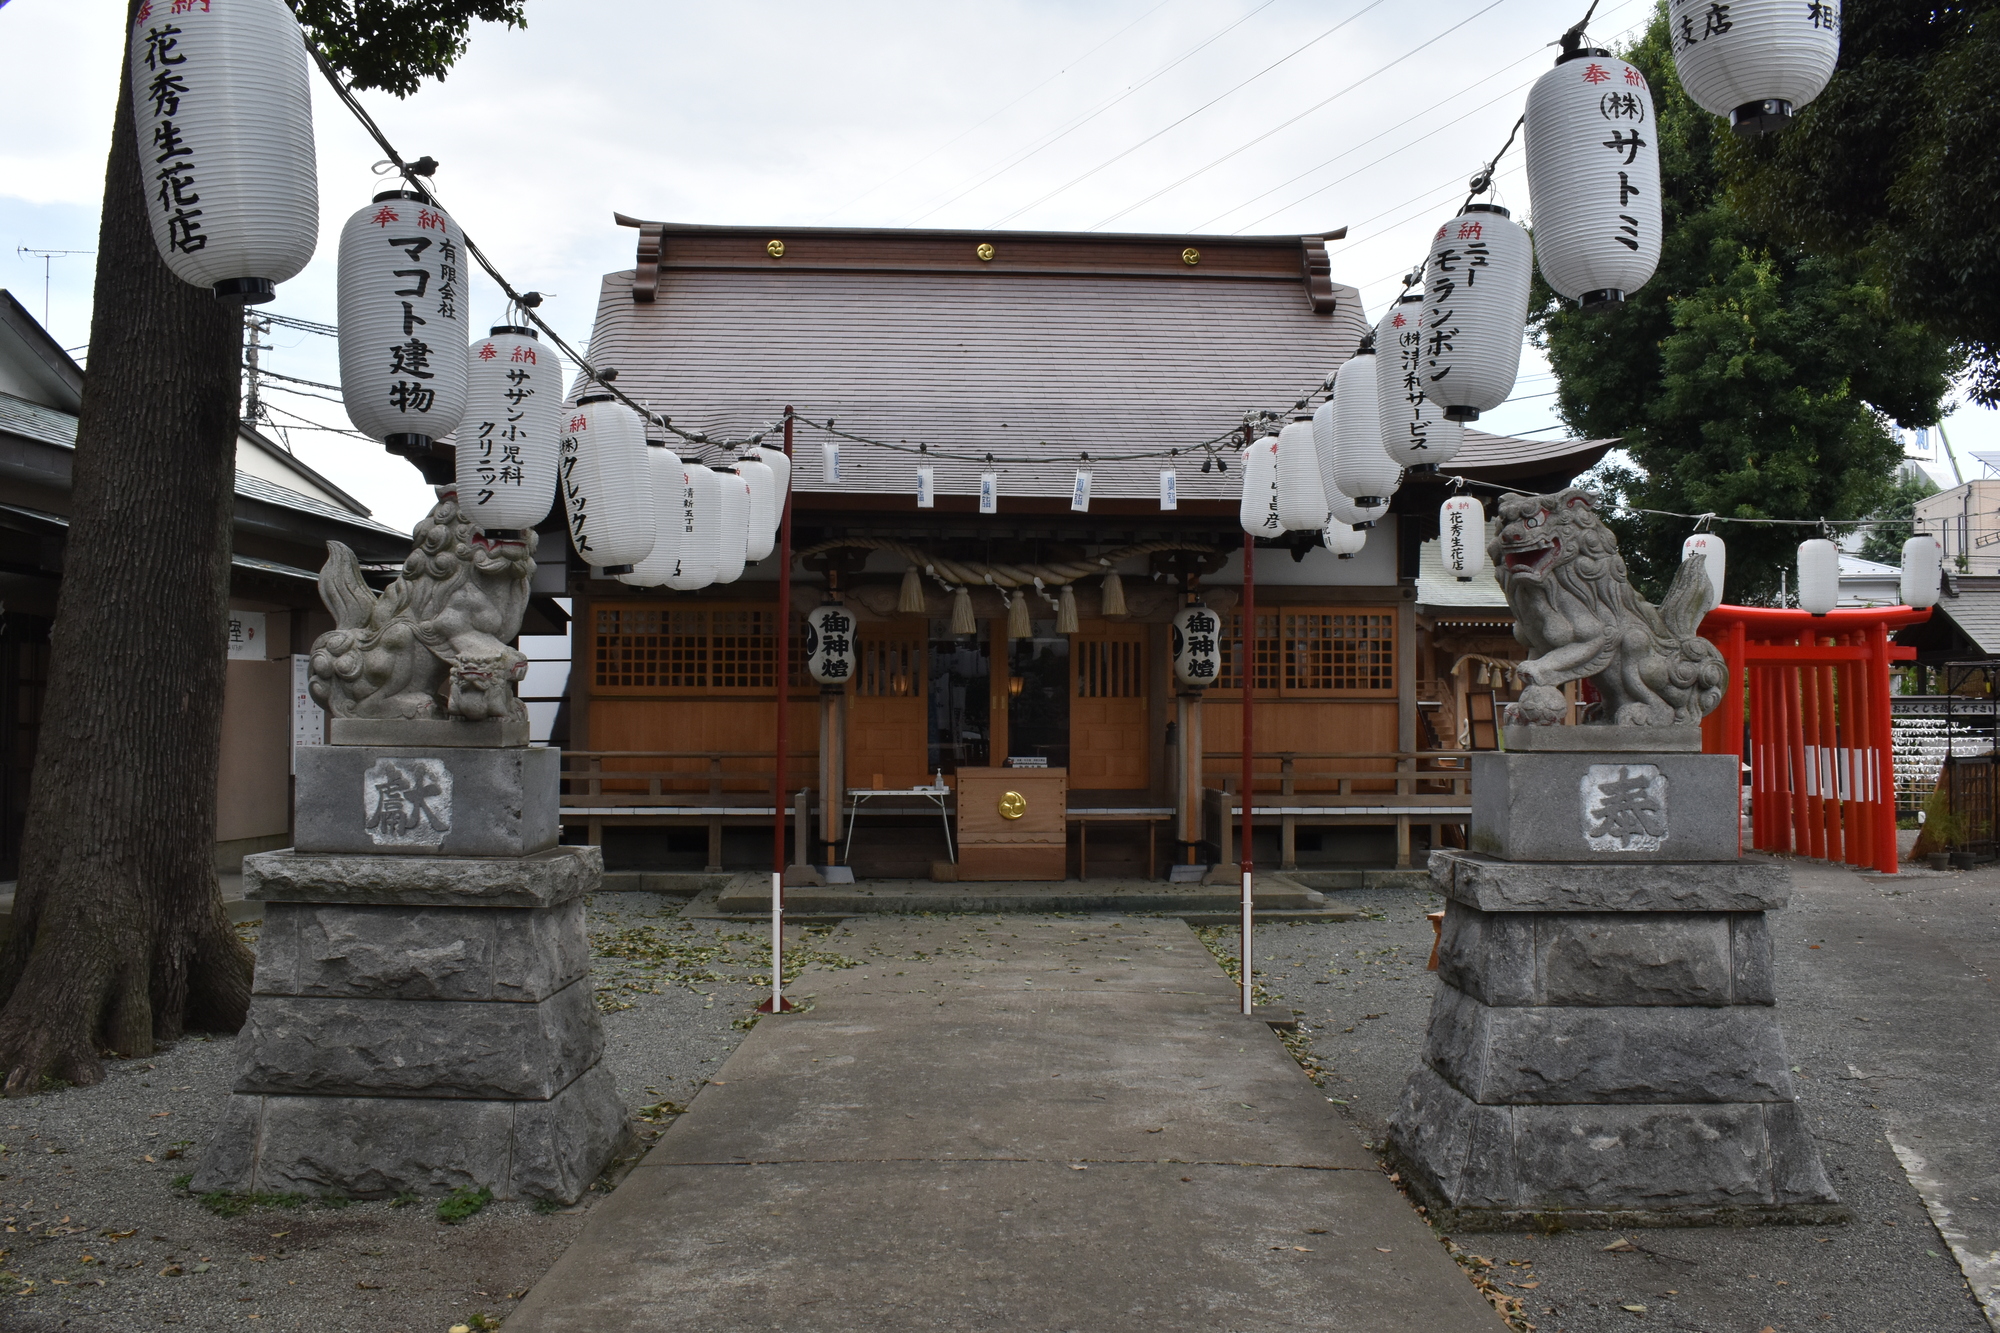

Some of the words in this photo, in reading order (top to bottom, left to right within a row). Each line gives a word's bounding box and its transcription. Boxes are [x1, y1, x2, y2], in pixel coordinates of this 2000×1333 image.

[1582, 63, 1646, 91] 奉納
[144, 24, 208, 254] 花秀生花店
[1600, 92, 1647, 252] (株)サトミ
[371, 206, 447, 233] 奉納
[1436, 221, 1483, 241] 奉納
[437, 238, 457, 321] 有限会社
[1464, 243, 1490, 288] ニュー
[388, 236, 436, 413] マコト建物
[1391, 312, 1422, 329] 奉
[1427, 249, 1462, 382] モランボン
[479, 342, 537, 366] 奉納
[1400, 330, 1432, 450] (株清和サービス
[499, 368, 535, 487] サザン小児科
[476, 421, 497, 506] クリニック
[683, 487, 694, 533] 清新五丁目
[1450, 511, 1464, 571] 花秀生花店
[820, 611, 850, 678] 御神燈
[1185, 612, 1215, 678] 御神燈
[1589, 765, 1665, 848] 奉
